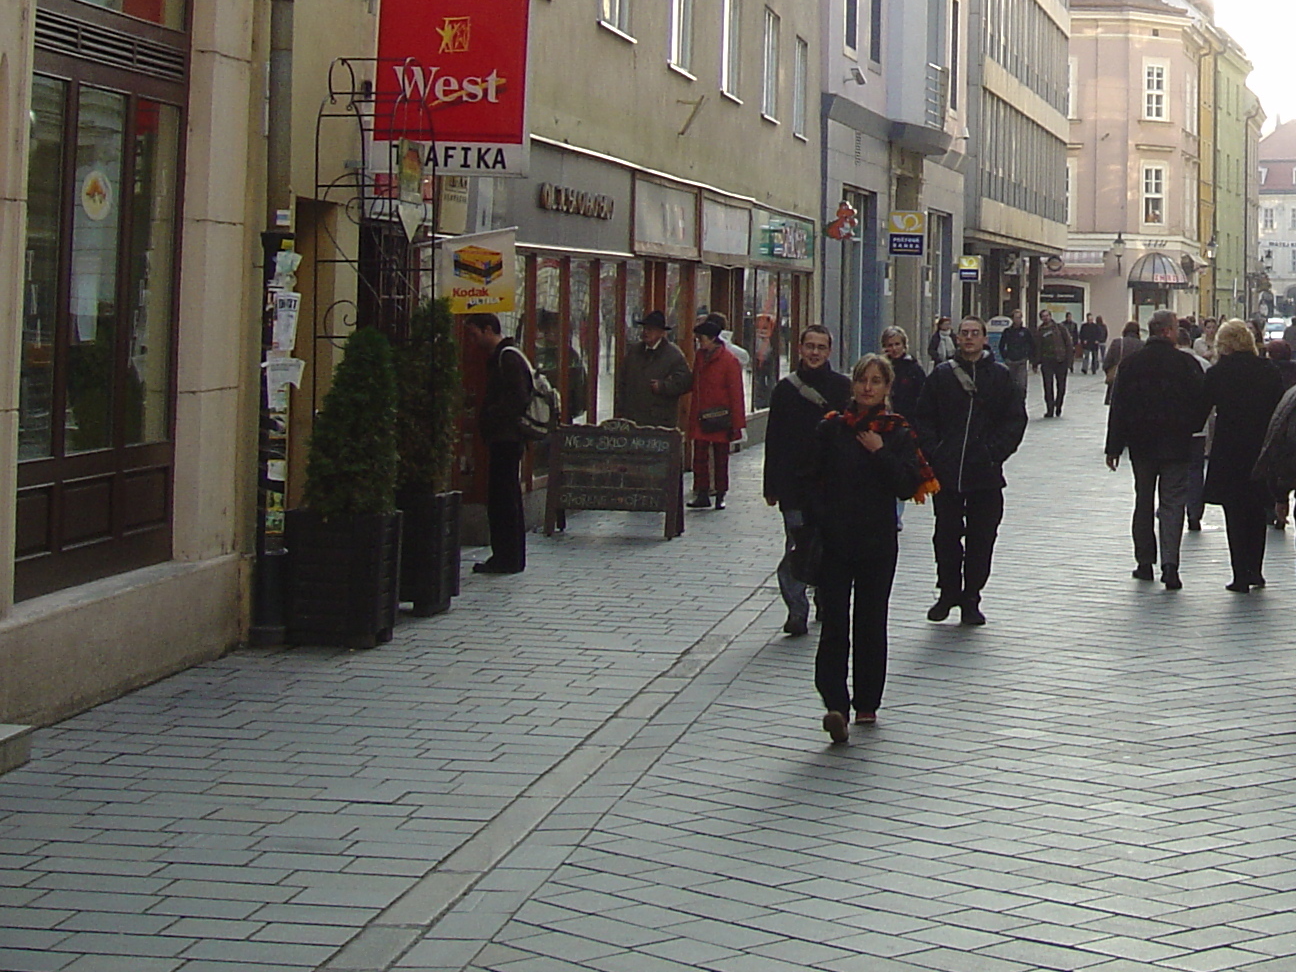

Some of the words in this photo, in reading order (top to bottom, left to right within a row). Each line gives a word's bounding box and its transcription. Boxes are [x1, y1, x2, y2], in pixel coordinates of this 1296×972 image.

[393, 65, 500, 103] West
[391, 144, 507, 170] TAFIKA
[452, 287, 490, 298] Kodak
